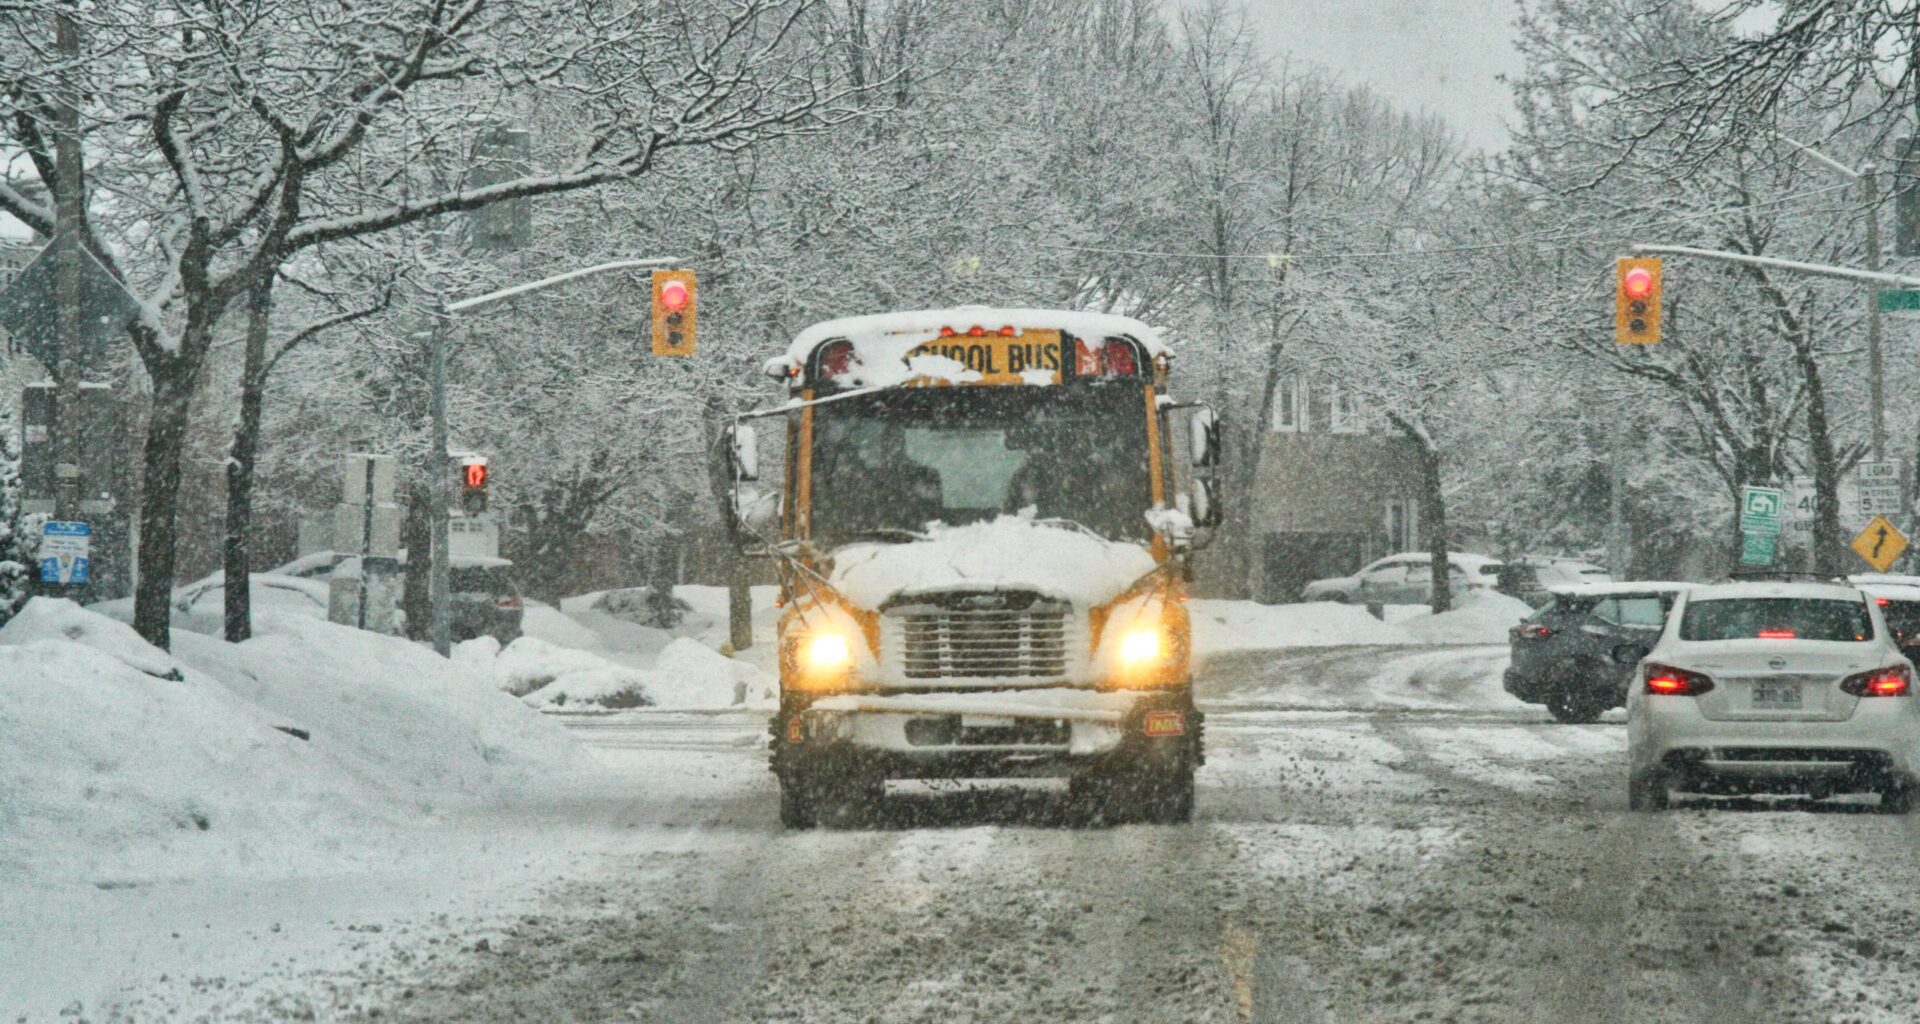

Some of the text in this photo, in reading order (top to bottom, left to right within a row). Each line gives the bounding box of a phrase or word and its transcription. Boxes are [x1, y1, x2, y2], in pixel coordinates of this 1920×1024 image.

[1008, 343, 1060, 374] BUS
[1867, 465, 1894, 477] LOAD
[1862, 498, 1873, 511] 5
